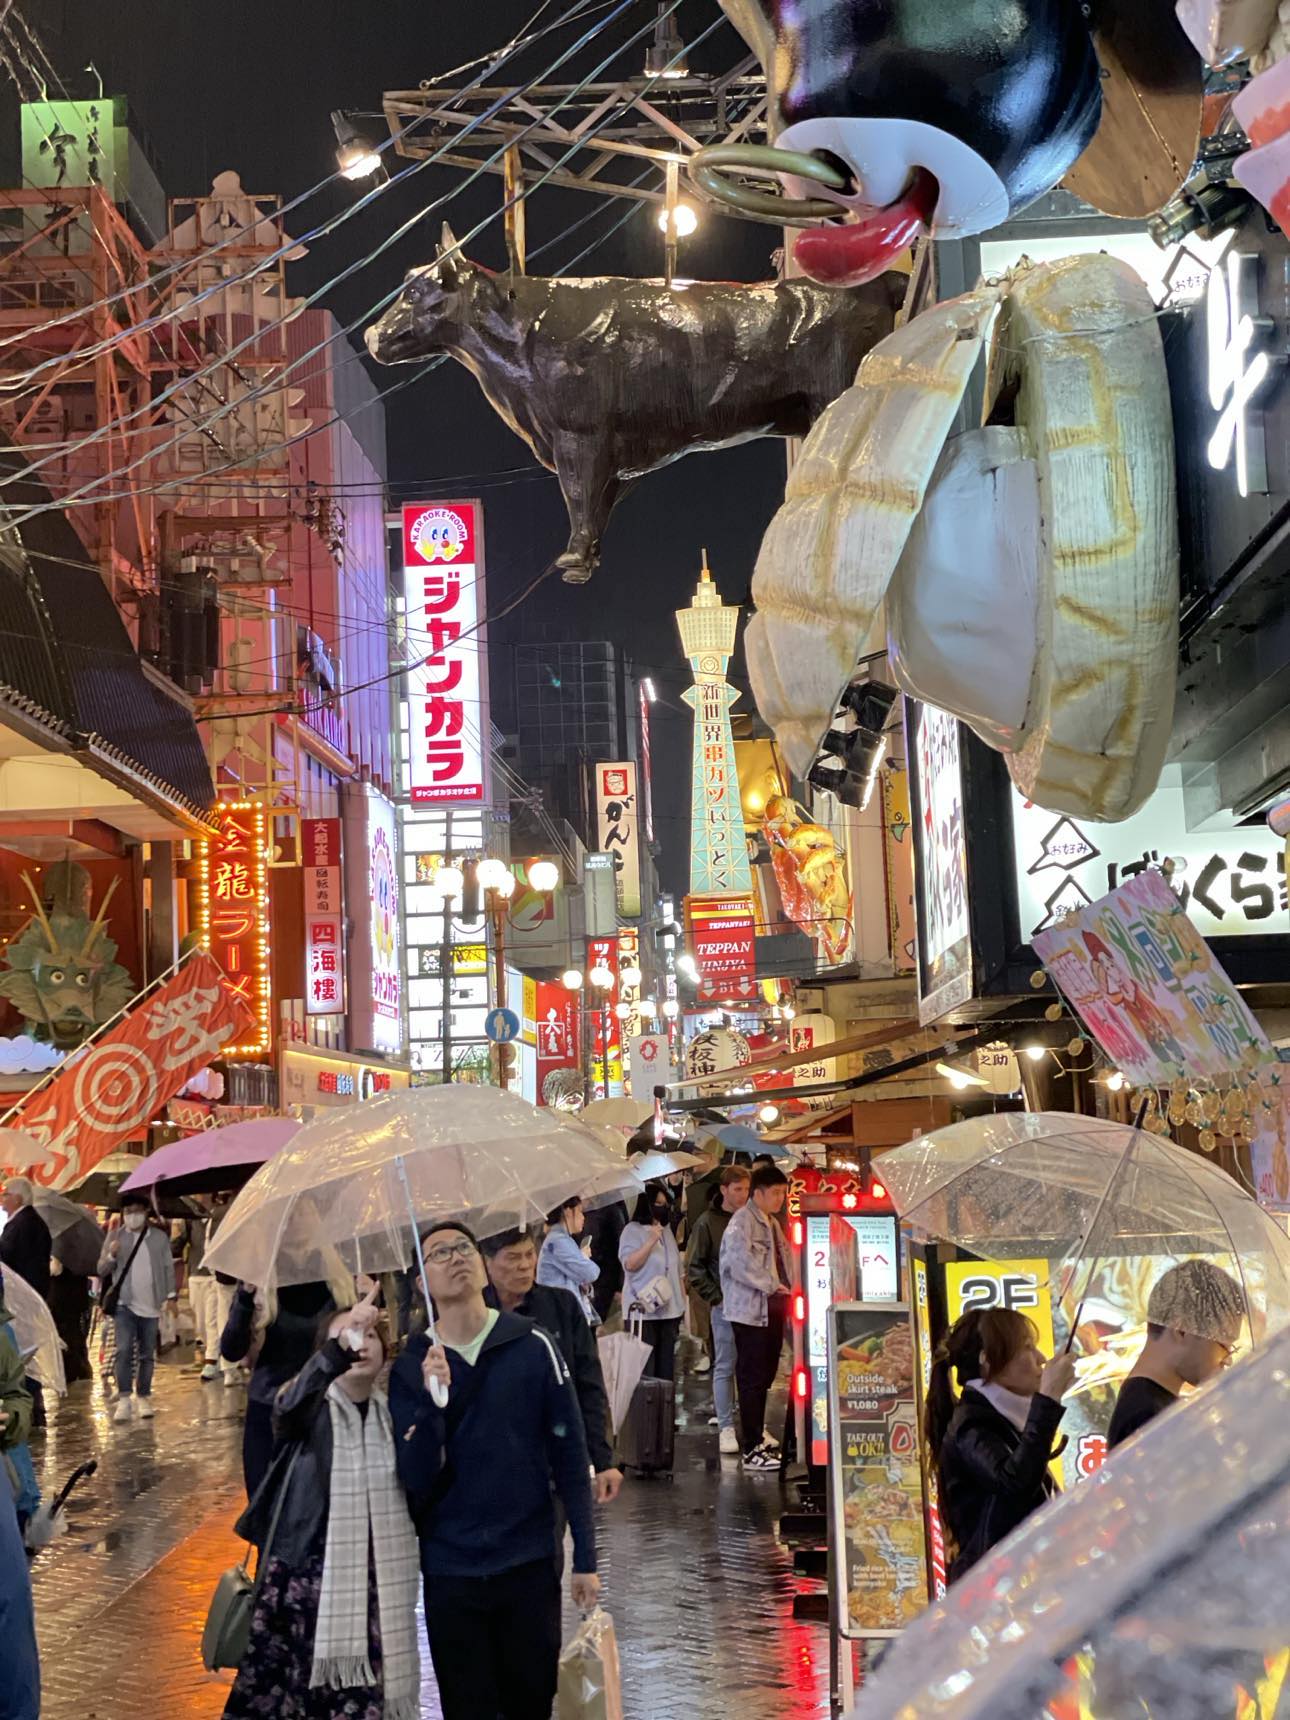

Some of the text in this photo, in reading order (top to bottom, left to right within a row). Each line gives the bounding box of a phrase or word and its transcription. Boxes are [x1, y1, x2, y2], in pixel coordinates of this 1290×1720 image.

[424, 572, 464, 782] ジャンカラ
[1051, 843, 1088, 855] お好み
[212, 816, 255, 1000] 金龍ラーメ
[697, 941, 752, 955] TEPPAN
[961, 1276, 1036, 1310] 2F
[847, 1374, 884, 1383] Outside
[847, 1384, 898, 1394] skirt steak
[847, 1433, 884, 1442] TAKE OUT
